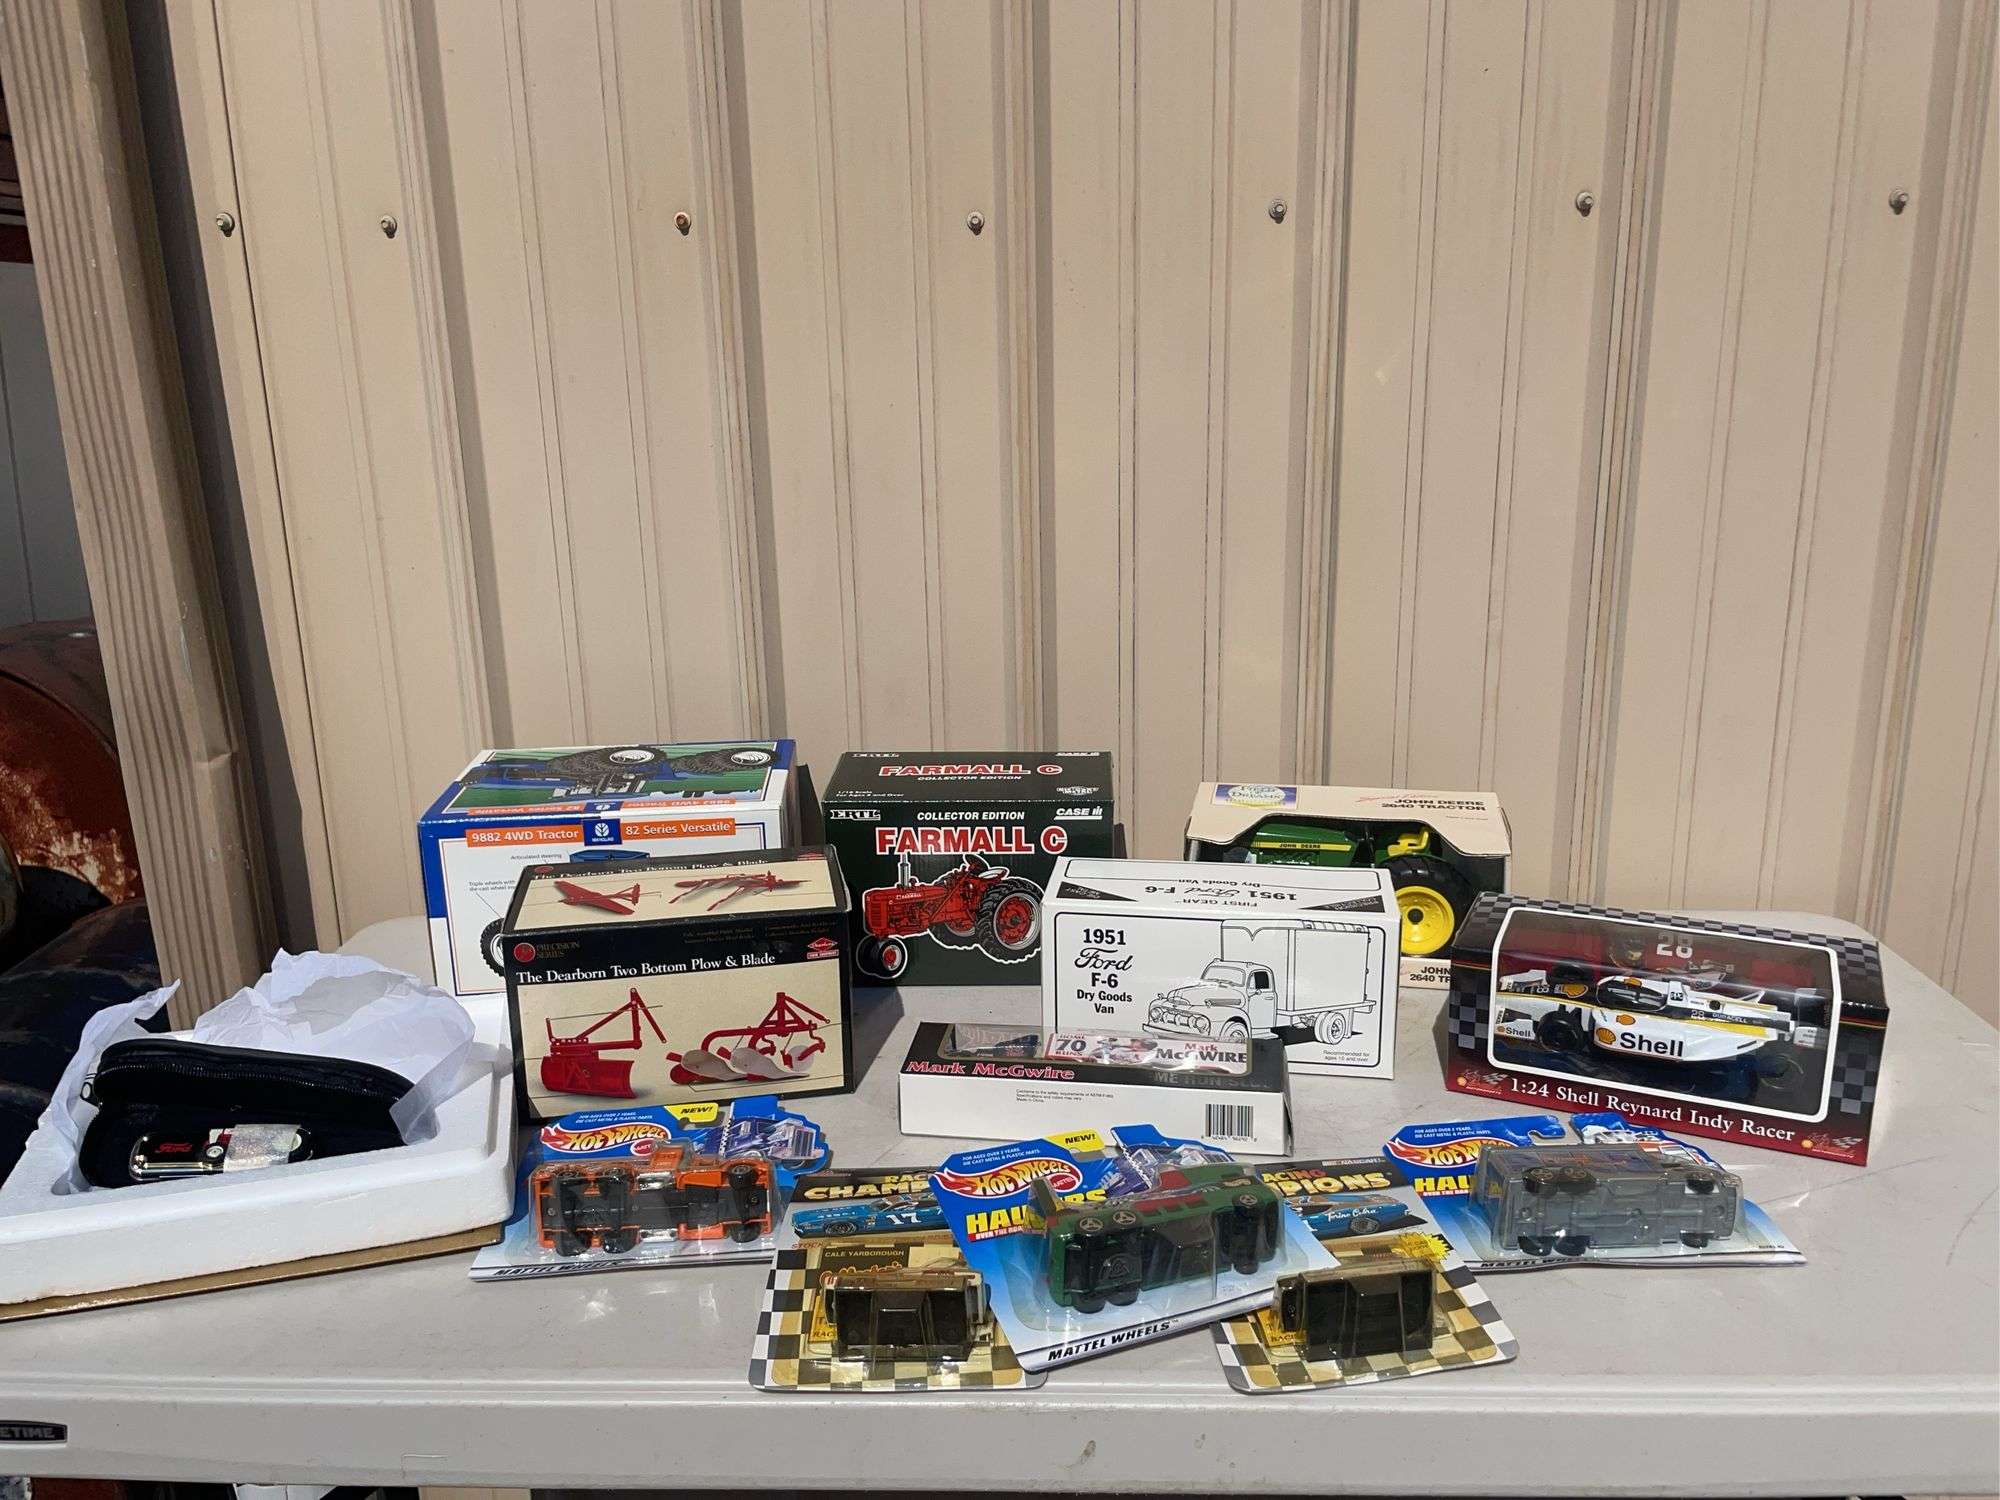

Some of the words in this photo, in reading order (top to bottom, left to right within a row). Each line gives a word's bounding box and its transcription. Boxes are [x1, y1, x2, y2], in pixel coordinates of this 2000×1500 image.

[879, 764, 1031, 777] FARMALL
[1037, 764, 1063, 775] C
[830, 810, 880, 820] ERTL
[917, 812, 979, 821] COLLECTOR
[982, 811, 1025, 820] EDITION
[1056, 808, 1090, 816] CASE
[625, 826, 640, 835] 82
[644, 824, 678, 834] Series
[680, 822, 731, 833] Versatile
[471, 832, 502, 843] 9882
[504, 830, 533, 841] 4WD
[538, 829, 579, 840] Tractor
[875, 826, 1034, 855] FARMALL
[1040, 825, 1067, 855] C
[1145, 886, 1176, 894] F-6
[1184, 887, 1240, 898] Ford
[1248, 890, 1297, 900] 1951
[1083, 928, 1126, 945] 1951
[1656, 934, 1693, 959] 28
[1074, 947, 1133, 971] Ford
[516, 971, 543, 984] The
[546, 967, 607, 983] Dearborn
[610, 964, 637, 977] Two
[641, 962, 687, 976] Bottom
[691, 957, 726, 971] Plow
[725, 956, 739, 967] &
[741, 952, 776, 966] Blade
[1421, 966, 1451, 976] JOHN
[1091, 972, 1118, 988] F-6
[1410, 974, 1436, 983] 2640
[1077, 989, 1095, 1001] Dry
[1098, 990, 1132, 1002] Goods
[1094, 1003, 1115, 1014] Van
[1690, 1009, 1705, 1019] 28
[1712, 1012, 1748, 1024] DURACELL
[1506, 1027, 1531, 1037] Shell
[1056, 1039, 1086, 1051] 70
[1185, 1043, 1218, 1052] Mark
[1620, 1032, 1684, 1057] Shell
[906, 1061, 966, 1074] Mark
[971, 1062, 1075, 1080] McGwire
[681, 1106, 713, 1115] NEW!
[1511, 1078, 1549, 1097] 1:24
[1556, 1087, 1599, 1107] Shell
[1607, 1095, 1682, 1122] Reynard
[1689, 1109, 1734, 1133] Indy
[1741, 1119, 1796, 1141] Racer
[1065, 1134, 1095, 1144] NEW!
[885, 1174, 928, 1183] RAC
[1262, 1168, 1328, 1182] ACING
[804, 1182, 930, 1200] CHAMP
[1266, 1172, 1391, 1197] PIONS
[886, 1212, 922, 1225] 17
[1327, 1210, 1351, 1222] Torino
[1352, 1208, 1377, 1217] Cobra
[976, 1232, 994, 1240] OVER
[995, 1229, 1007, 1237] THE
[493, 1266, 553, 1276] MATTEL
[814, 1330, 833, 1338] RAC
[1047, 1338, 1106, 1361] MATTEL
[1110, 1321, 1170, 1344] WHEELS
[0, 1427, 55, 1438] ETIME
